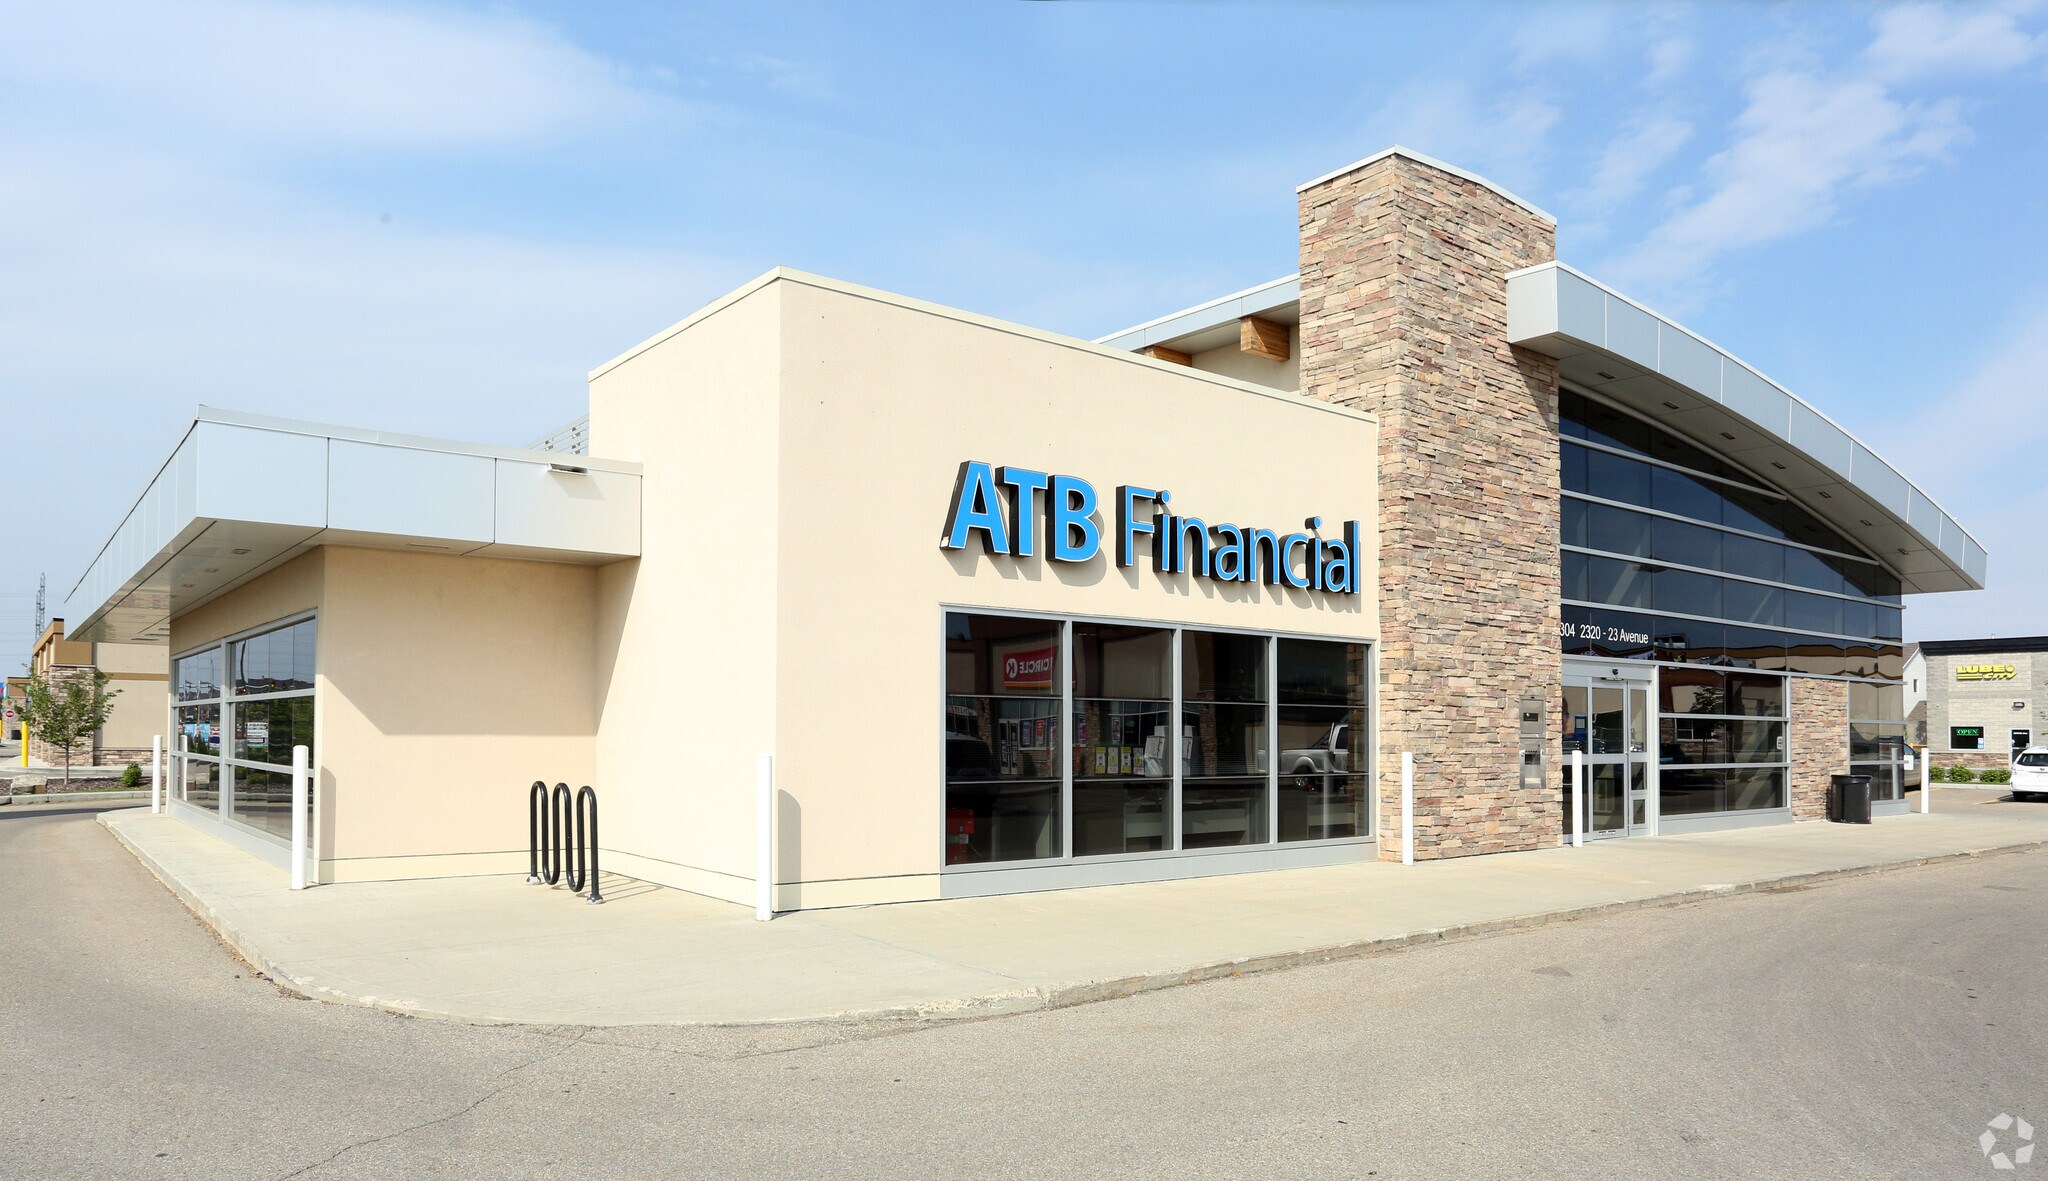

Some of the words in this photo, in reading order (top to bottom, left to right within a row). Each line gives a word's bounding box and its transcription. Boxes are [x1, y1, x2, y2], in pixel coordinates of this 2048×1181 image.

[941, 460, 1101, 562] ATB
[1116, 485, 1360, 594] Financial
[1580, 625, 1601, 640] 2320
[1608, 627, 1618, 642] 23
[1620, 629, 1648, 643] Avenue
[1957, 665, 2006, 673] LUBE
